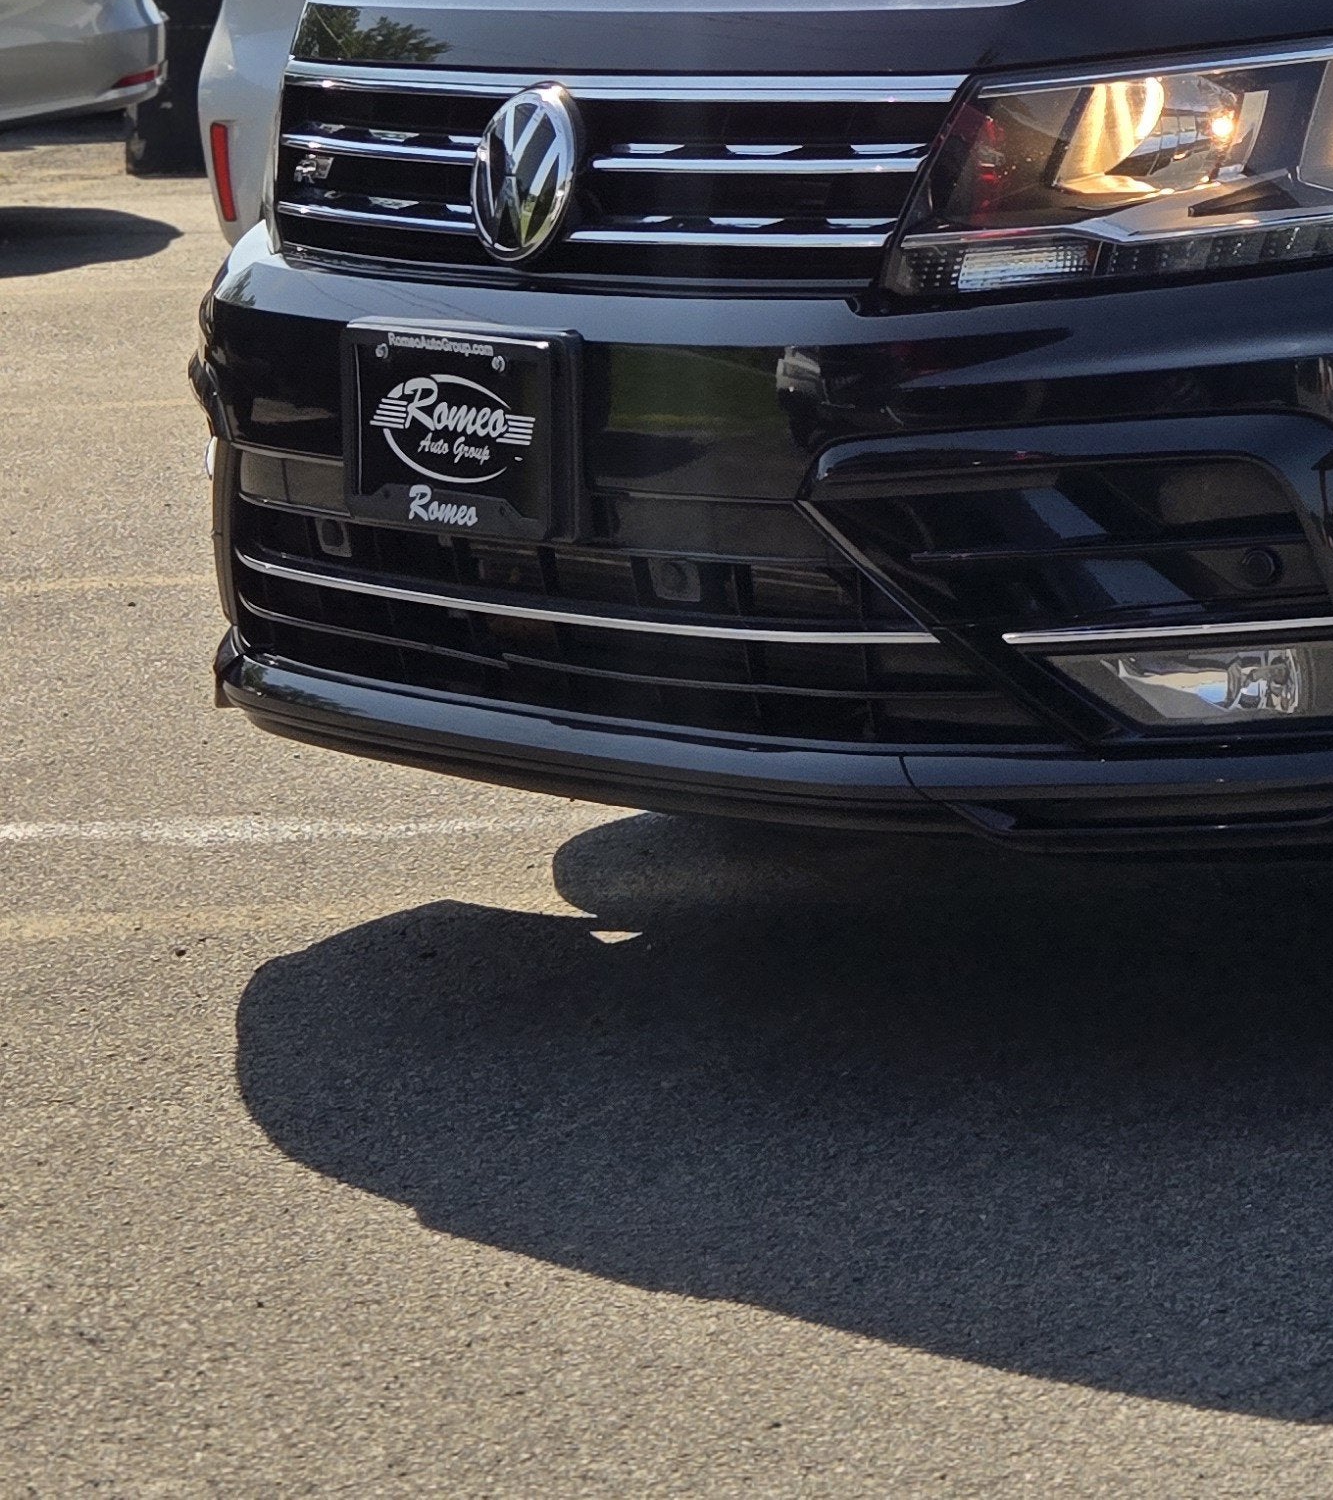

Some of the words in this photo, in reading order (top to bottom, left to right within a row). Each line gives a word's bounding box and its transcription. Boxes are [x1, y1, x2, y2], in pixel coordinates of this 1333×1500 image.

[387, 332, 494, 357] RomeoAutoGroup.com
[403, 377, 509, 438] Romeo
[417, 432, 449, 455] Auto
[452, 436, 491, 466] Group
[408, 484, 478, 527] Romeo
